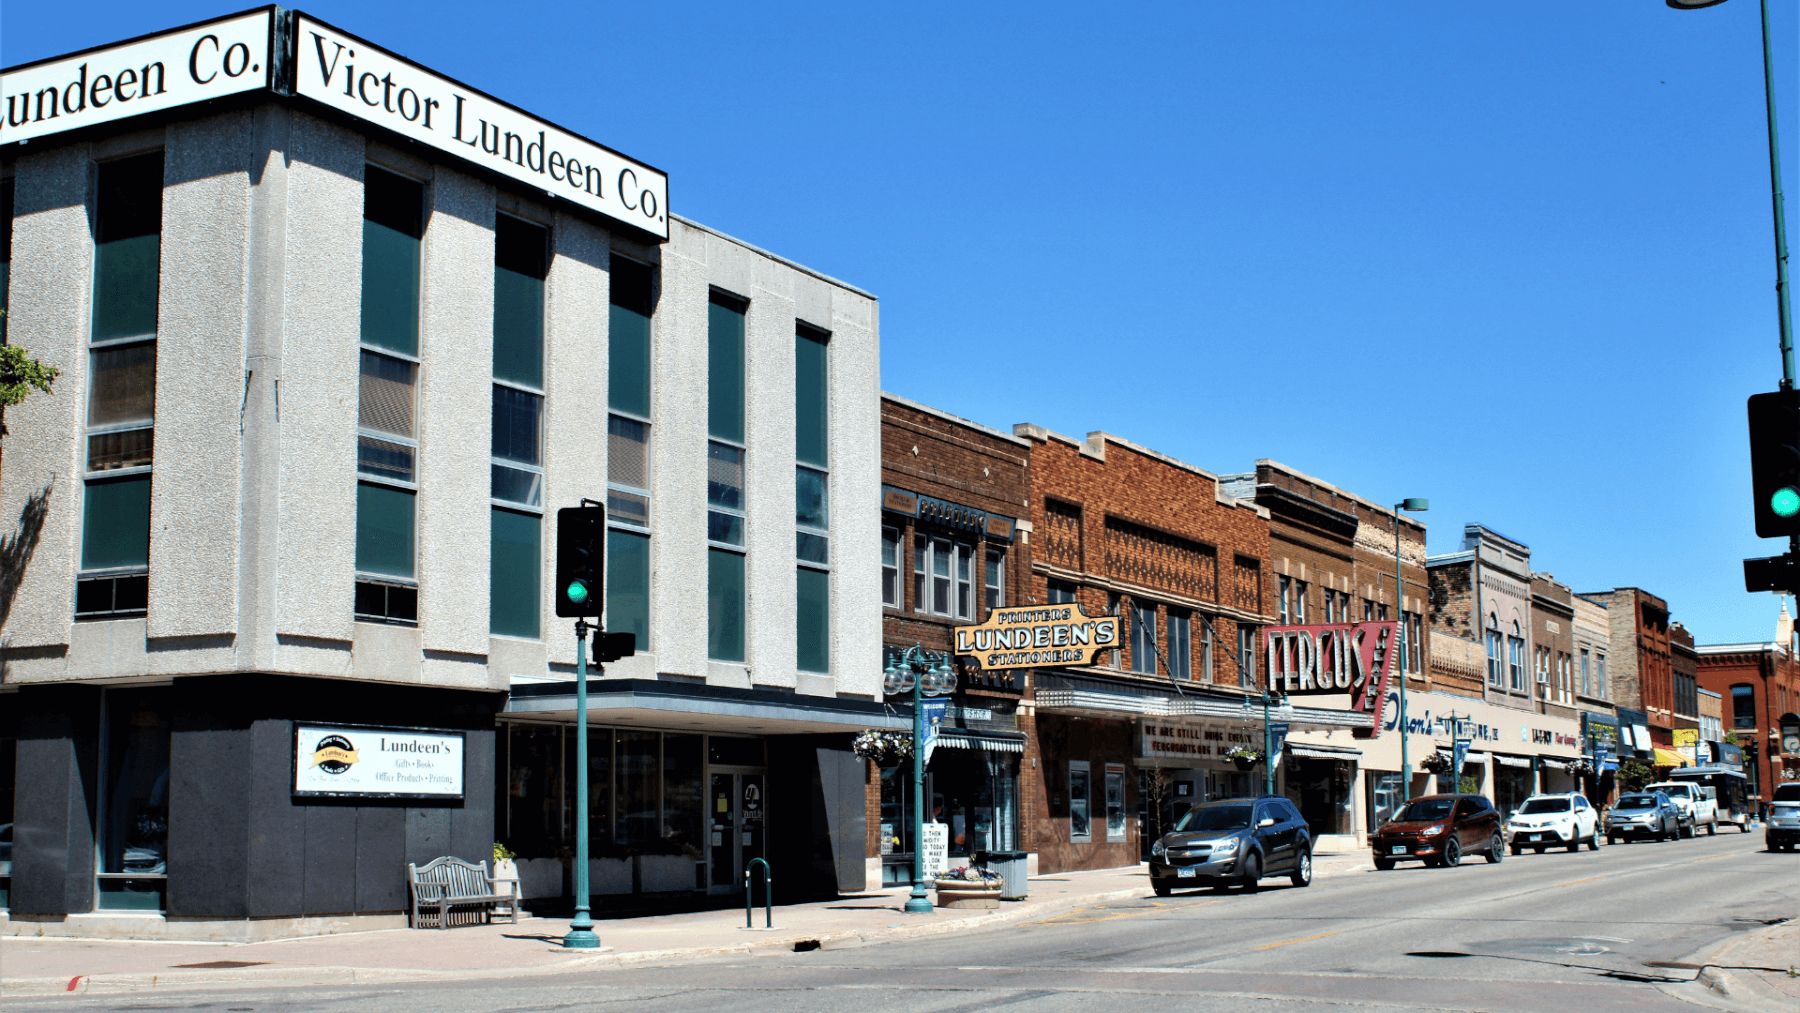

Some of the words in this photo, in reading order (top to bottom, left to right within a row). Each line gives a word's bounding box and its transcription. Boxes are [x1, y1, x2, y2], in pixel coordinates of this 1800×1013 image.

[0, 61, 166, 130] undeen
[189, 34, 260, 84] Co.
[309, 31, 439, 130] Victor
[454, 94, 605, 199] Lundeen
[618, 168, 665, 222] Co.
[998, 608, 1071, 624] PRINTERS
[958, 620, 1115, 651] LUNDEEN'S
[988, 649, 1083, 666] STATIONERS
[1268, 627, 1367, 691] FERGUS
[1364, 625, 1390, 709] THEATRE
[1145, 725, 1156, 736] WE
[1160, 726, 1174, 737] ARE
[1177, 728, 1200, 740] STILL
[380, 738, 451, 754] Lundeen's
[395, 759, 411, 768] Gifts
[416, 759, 434, 769] Books
[375, 772, 395, 782] Office
[396, 772, 424, 783] Products
[429, 774, 453, 784] Printing
